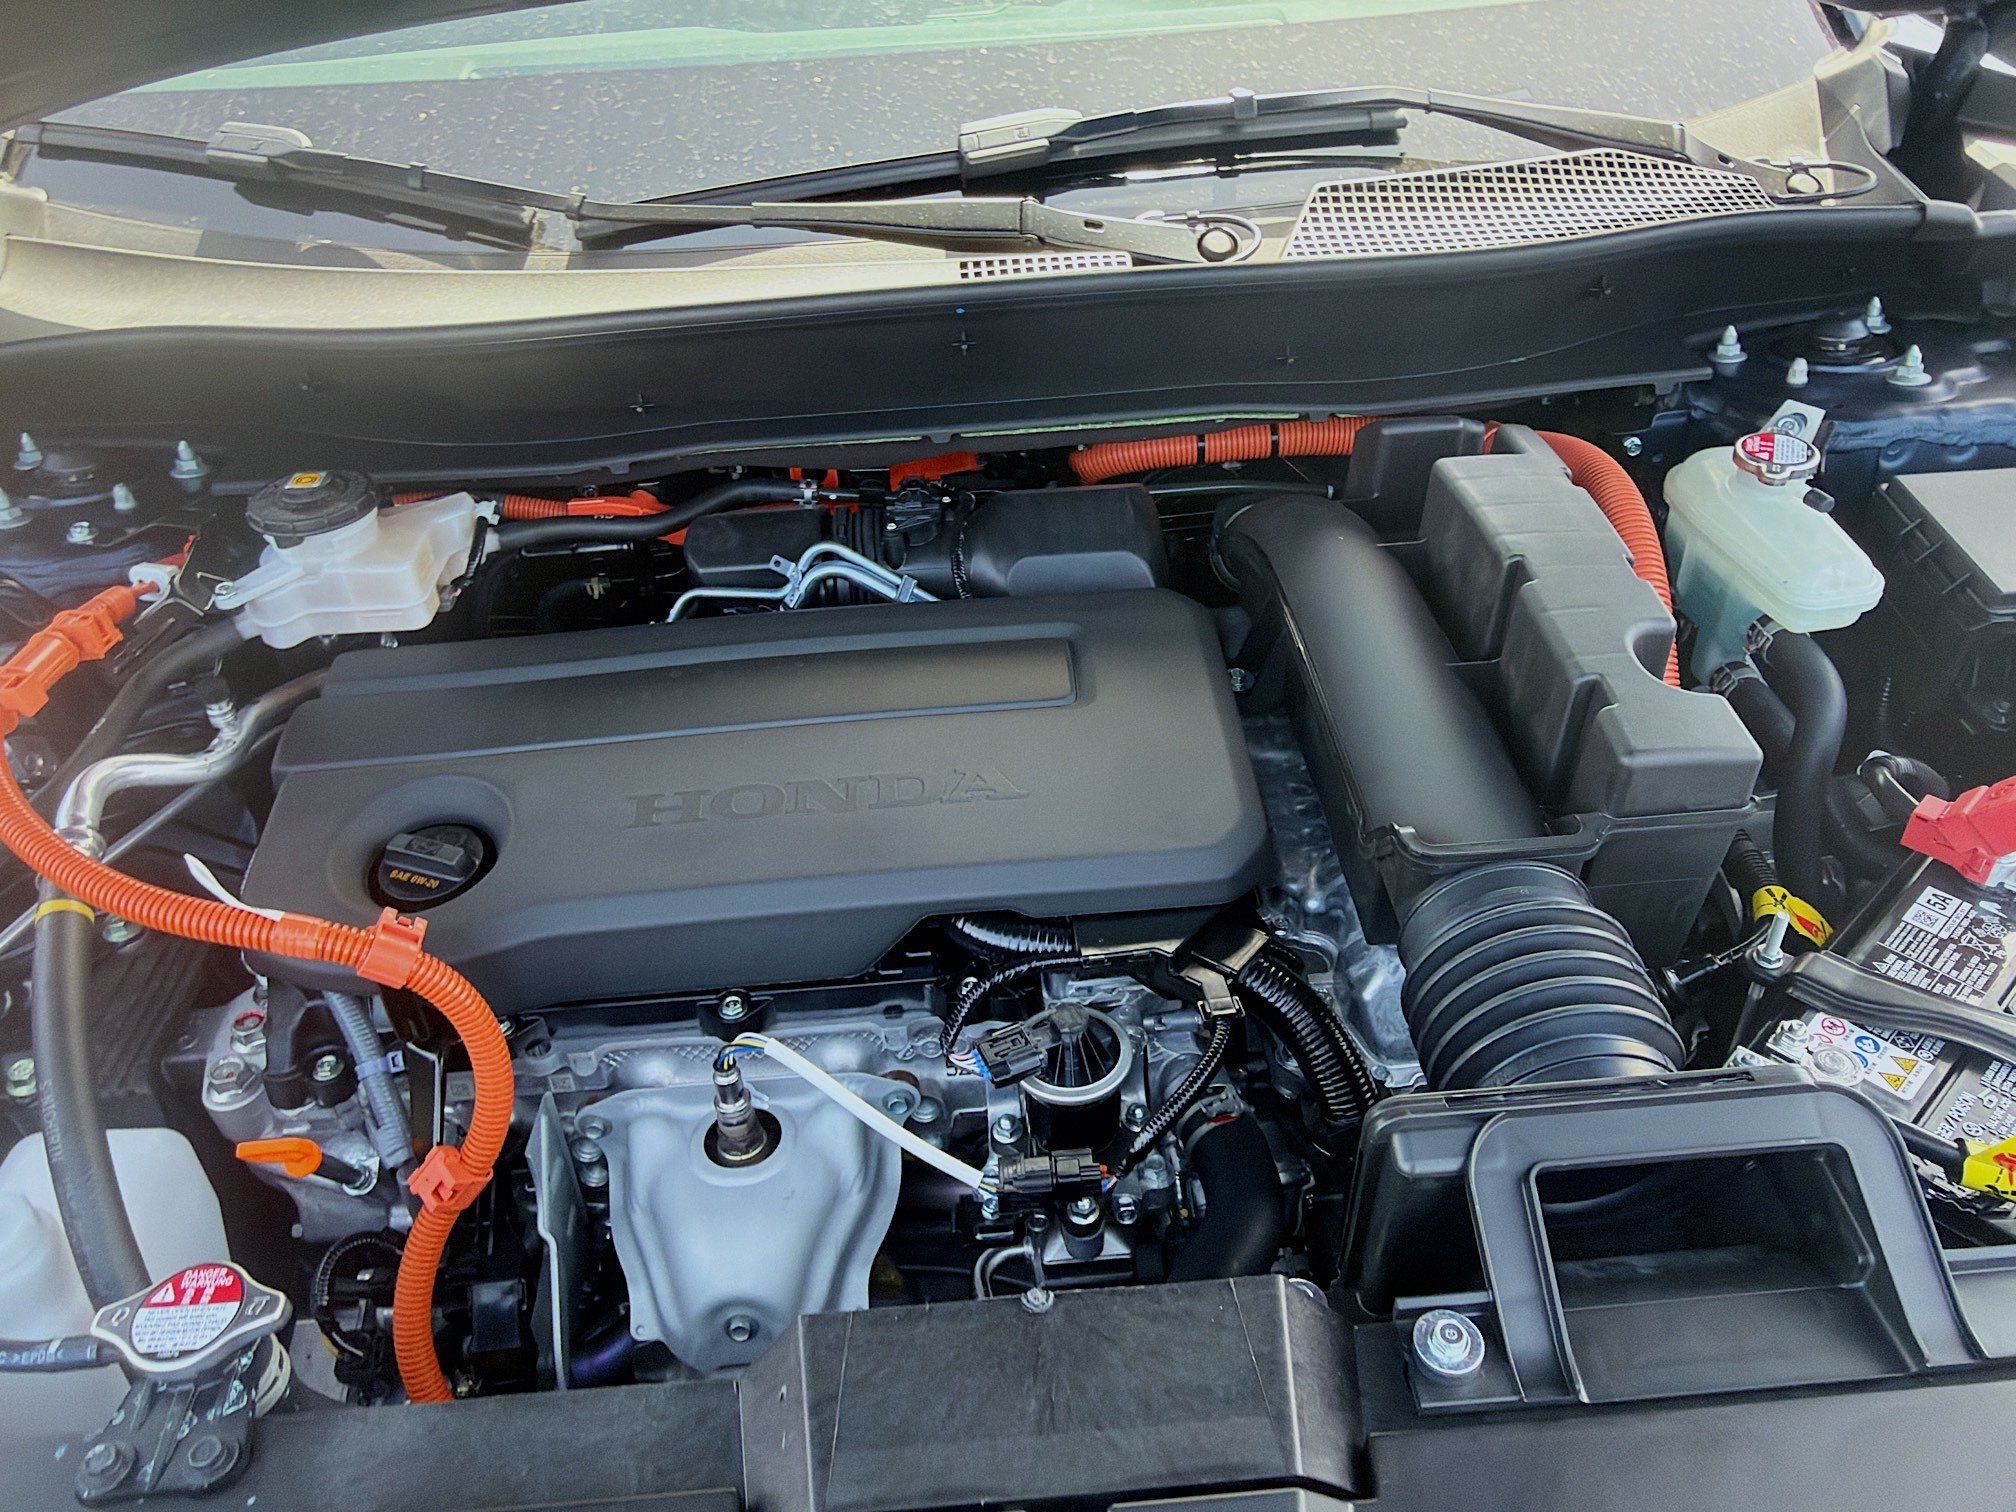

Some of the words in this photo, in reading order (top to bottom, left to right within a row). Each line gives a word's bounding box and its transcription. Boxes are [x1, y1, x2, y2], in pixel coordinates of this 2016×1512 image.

[622, 768, 1031, 828] HONDA
[389, 869, 411, 882] SAE
[1926, 893, 1953, 911] 5A
[181, 1274, 234, 1289] WARNUNG
[183, 1267, 228, 1281] DANGER
